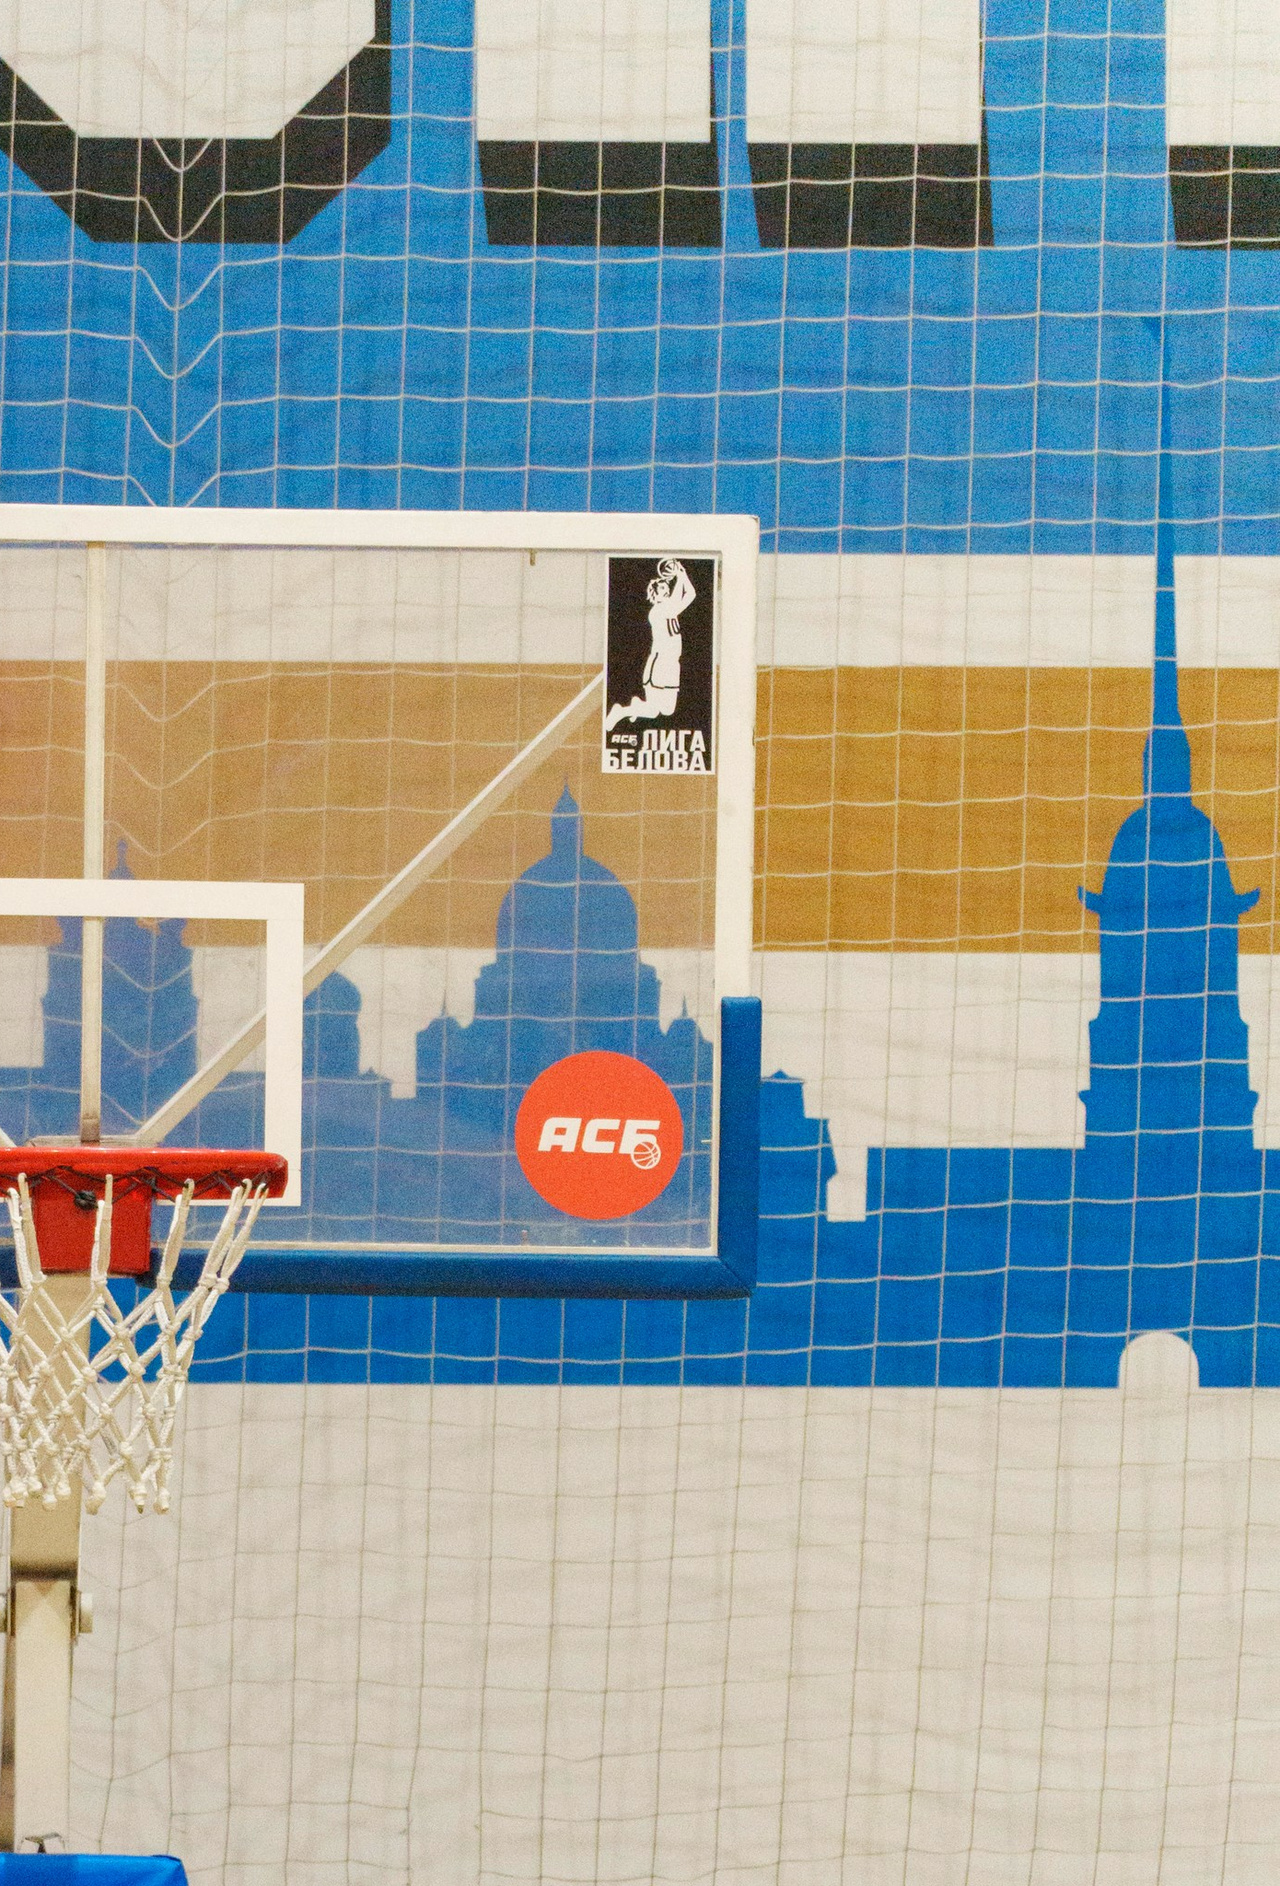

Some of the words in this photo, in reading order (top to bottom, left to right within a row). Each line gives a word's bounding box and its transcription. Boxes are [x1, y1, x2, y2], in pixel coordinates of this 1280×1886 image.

[642, 729, 706, 752] ЛИГА
[605, 749, 707, 771] БЕЛОВА
[537, 1117, 662, 1160] АСБ
